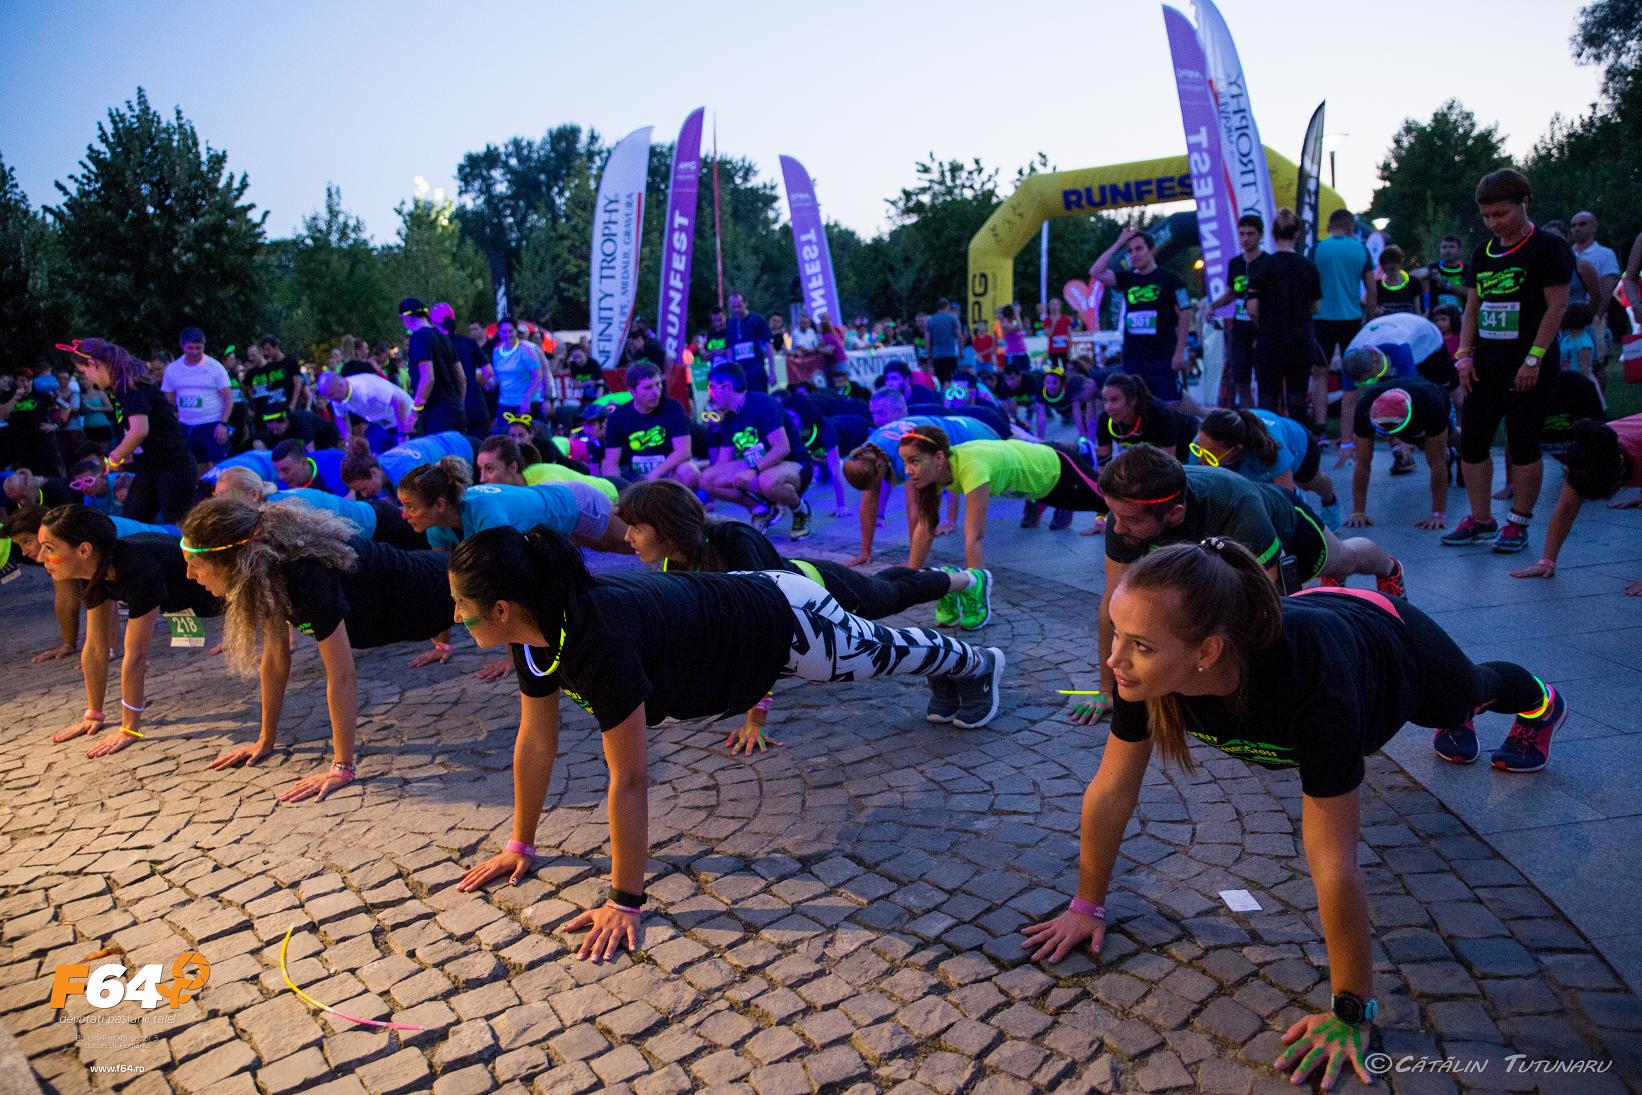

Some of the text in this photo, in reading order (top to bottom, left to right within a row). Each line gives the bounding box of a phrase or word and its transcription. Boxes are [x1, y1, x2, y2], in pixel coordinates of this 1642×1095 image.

[1062, 174, 1193, 211] RUNFES
[598, 193, 619, 368] NFINITY TROPHY
[665, 209, 689, 360] RUNFEST
[1482, 311, 1507, 327] 341
